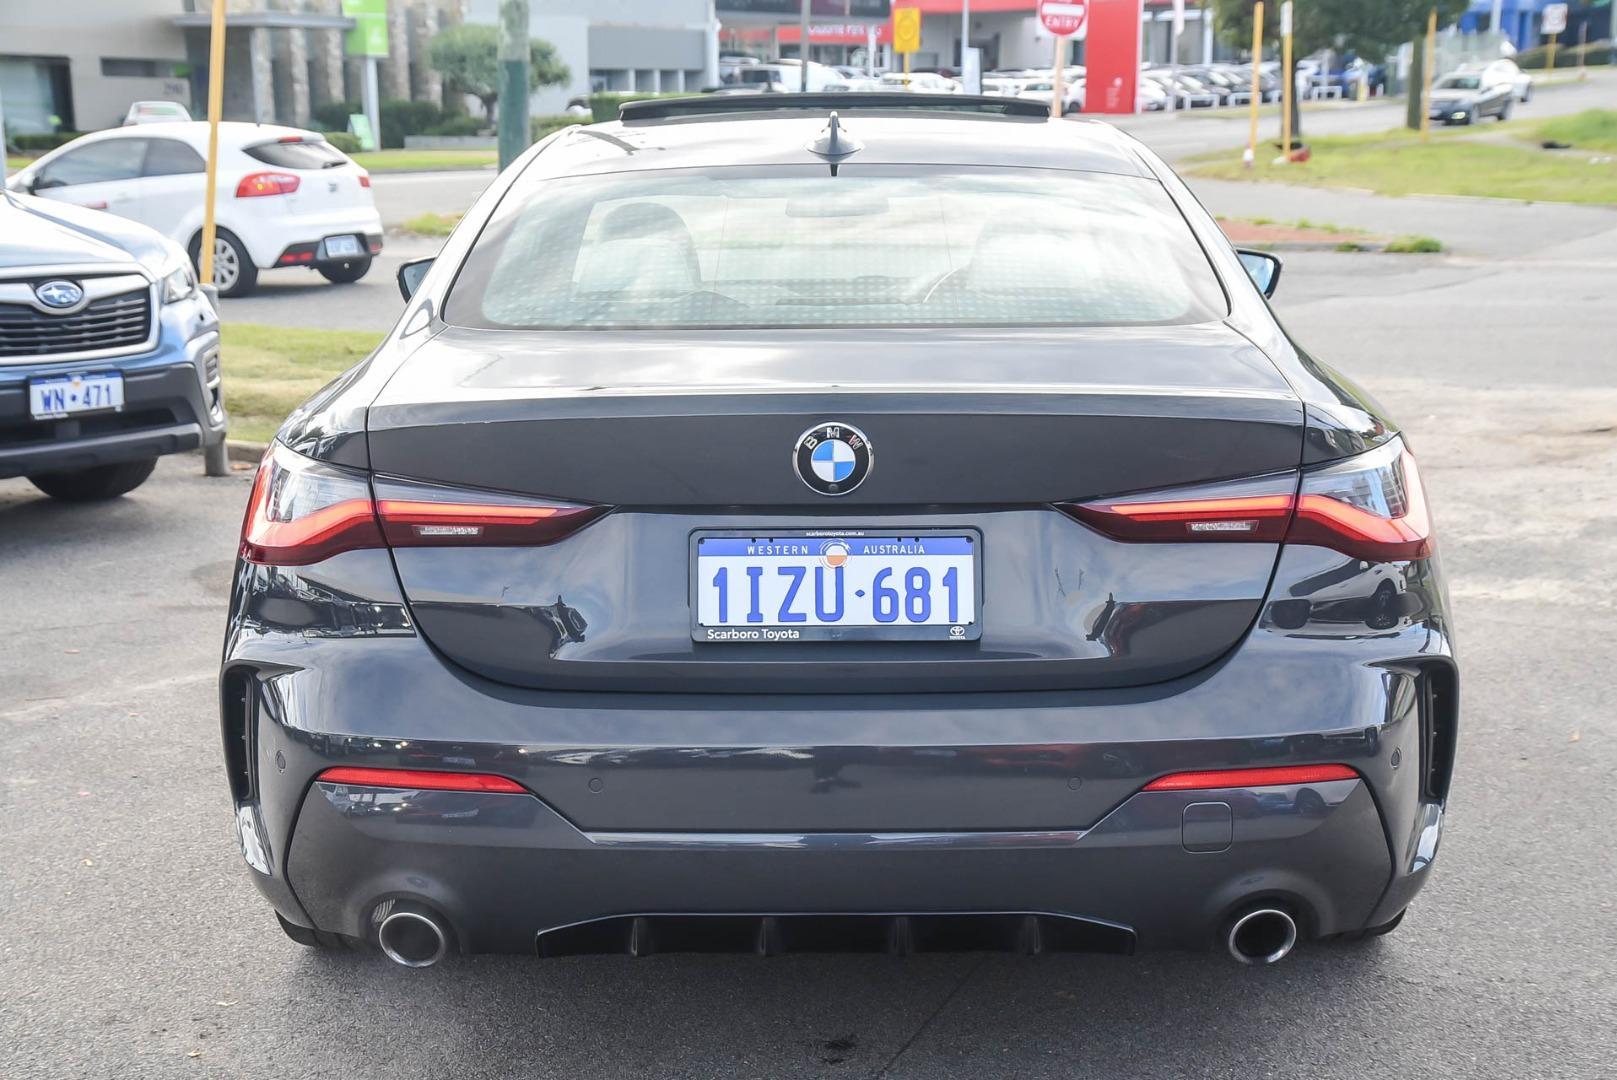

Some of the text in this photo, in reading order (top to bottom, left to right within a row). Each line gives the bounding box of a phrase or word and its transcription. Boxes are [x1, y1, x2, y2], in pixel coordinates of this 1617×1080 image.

[1045, 15, 1079, 29] ENTRY
[803, 426, 863, 450] BMW
[747, 544, 925, 555] WESTERN AUSTRALIA
[707, 628, 800, 641] Scarboro Toyota
